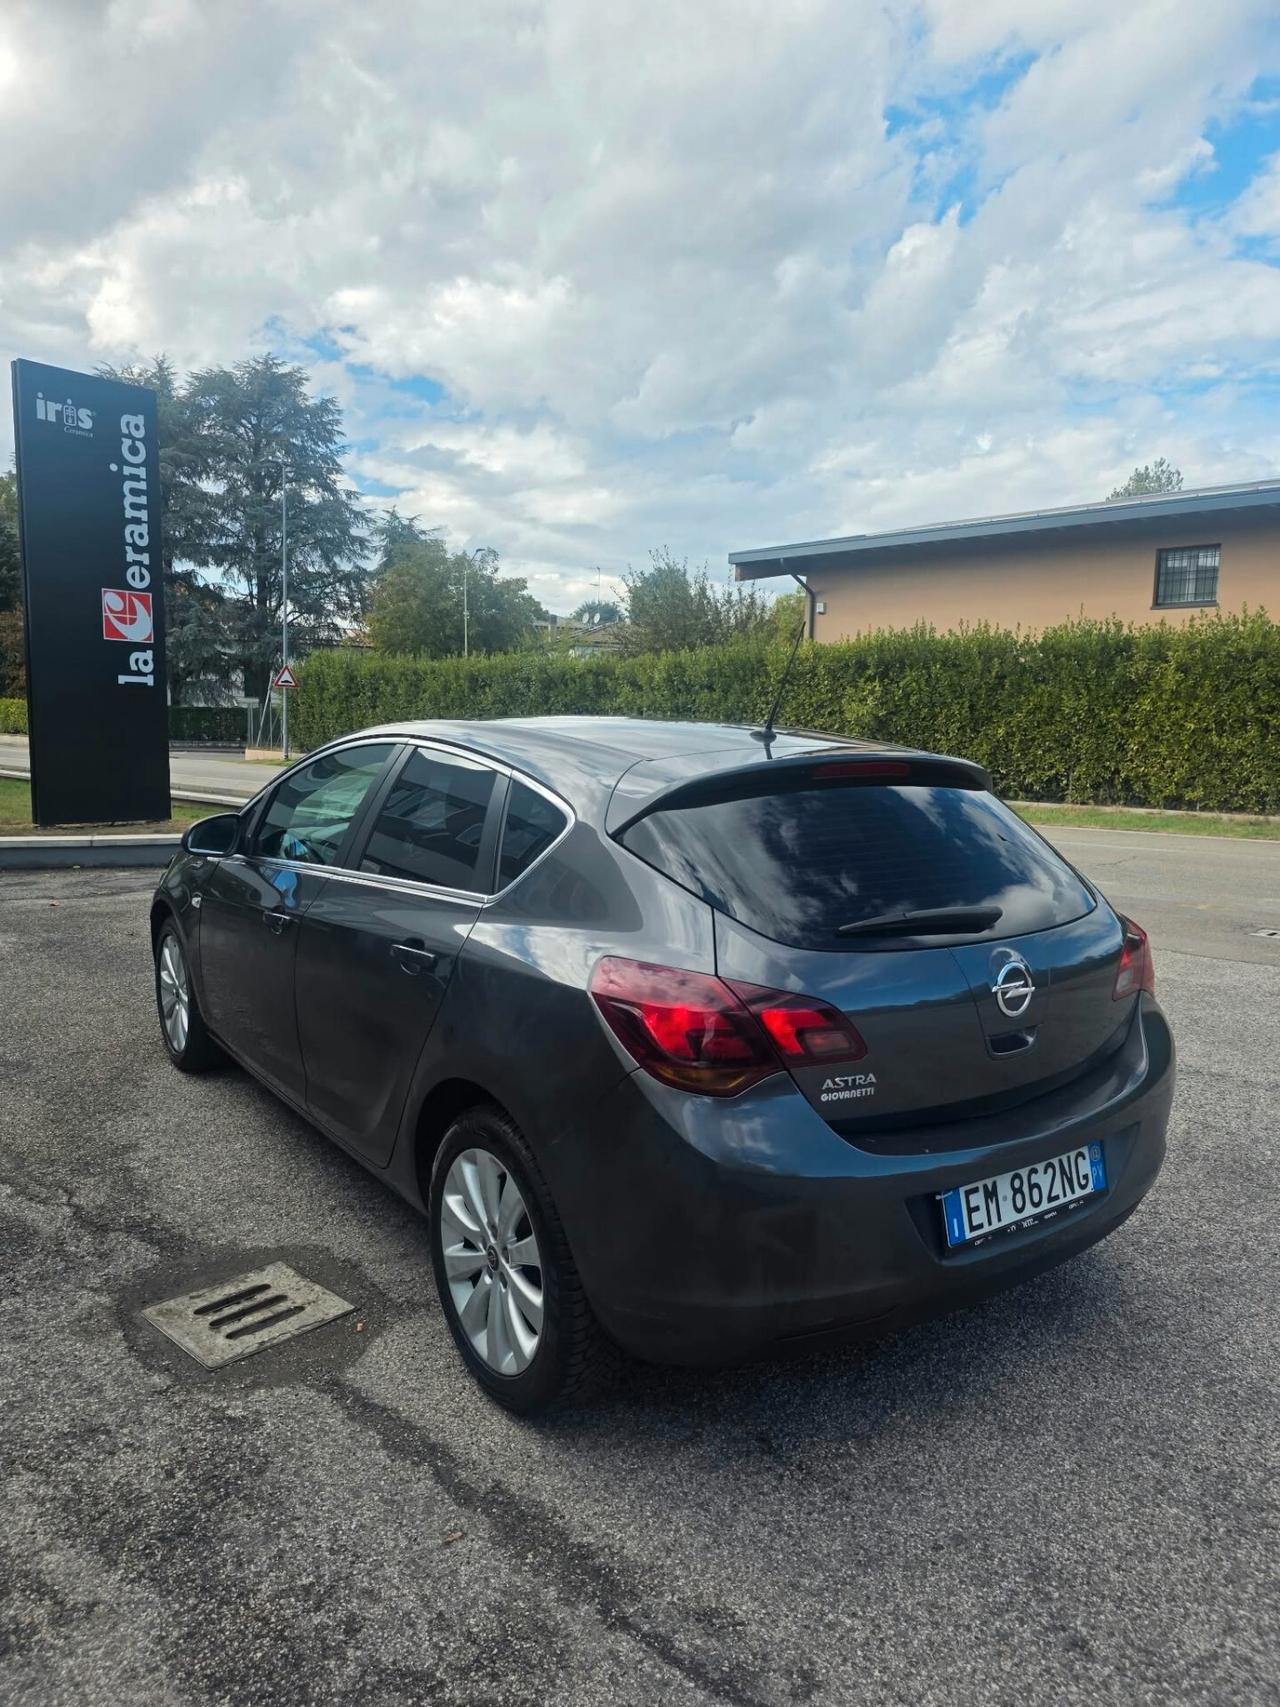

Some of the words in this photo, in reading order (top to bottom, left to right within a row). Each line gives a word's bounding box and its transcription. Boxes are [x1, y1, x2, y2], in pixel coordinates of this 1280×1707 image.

[36, 392, 93, 429] iris
[118, 649, 154, 687] la
[820, 1087, 875, 1102] GIOVANETTI
[821, 1073, 877, 1090] ASTRA
